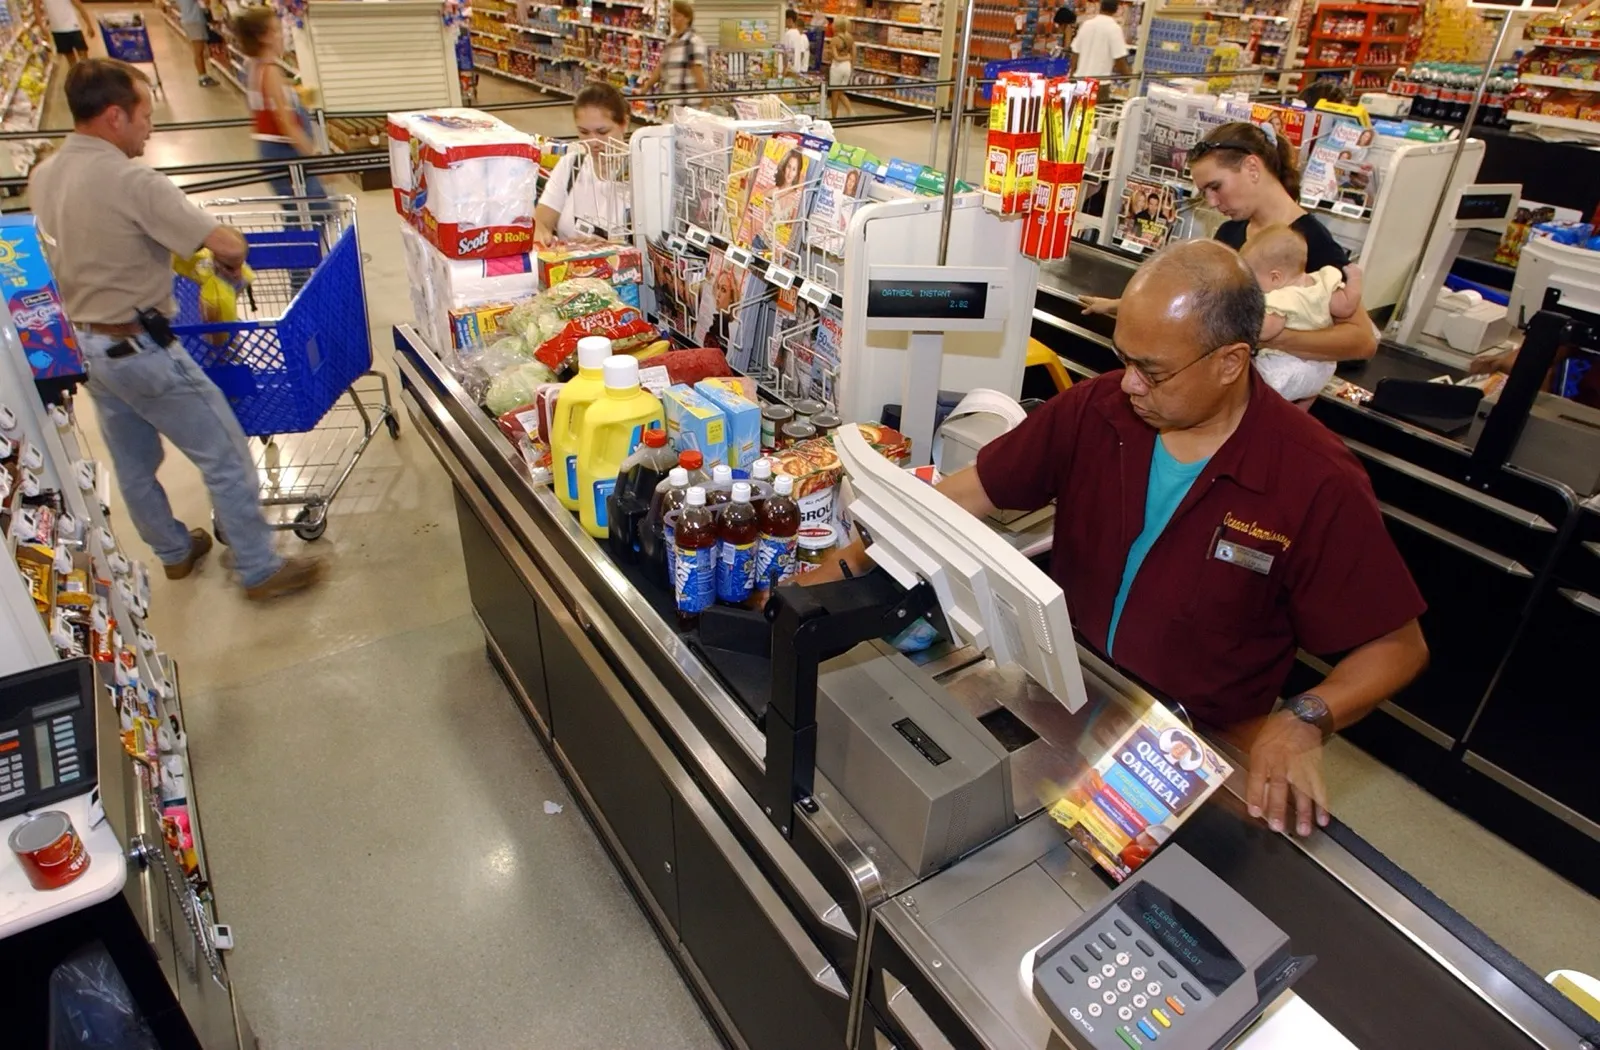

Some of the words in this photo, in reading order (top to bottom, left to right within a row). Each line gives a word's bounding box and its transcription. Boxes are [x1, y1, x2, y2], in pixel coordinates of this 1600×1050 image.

[458, 229, 490, 256] Scott
[494, 232, 503, 244] 8
[504, 231, 530, 243] Rolls
[882, 288, 914, 297] OATMEAL
[919, 290, 951, 298] INSTANT
[1121, 752, 1182, 810] OATMEAL
[1136, 741, 1191, 792] QUAKER
[1143, 912, 1161, 930] CARD
[1163, 930, 1182, 948] THRU
[1183, 947, 1204, 966] SLOT
[1151, 903, 1178, 929] PLEASE
[1179, 928, 1198, 947] PASS
[1080, 1018, 1095, 1033] NCR
